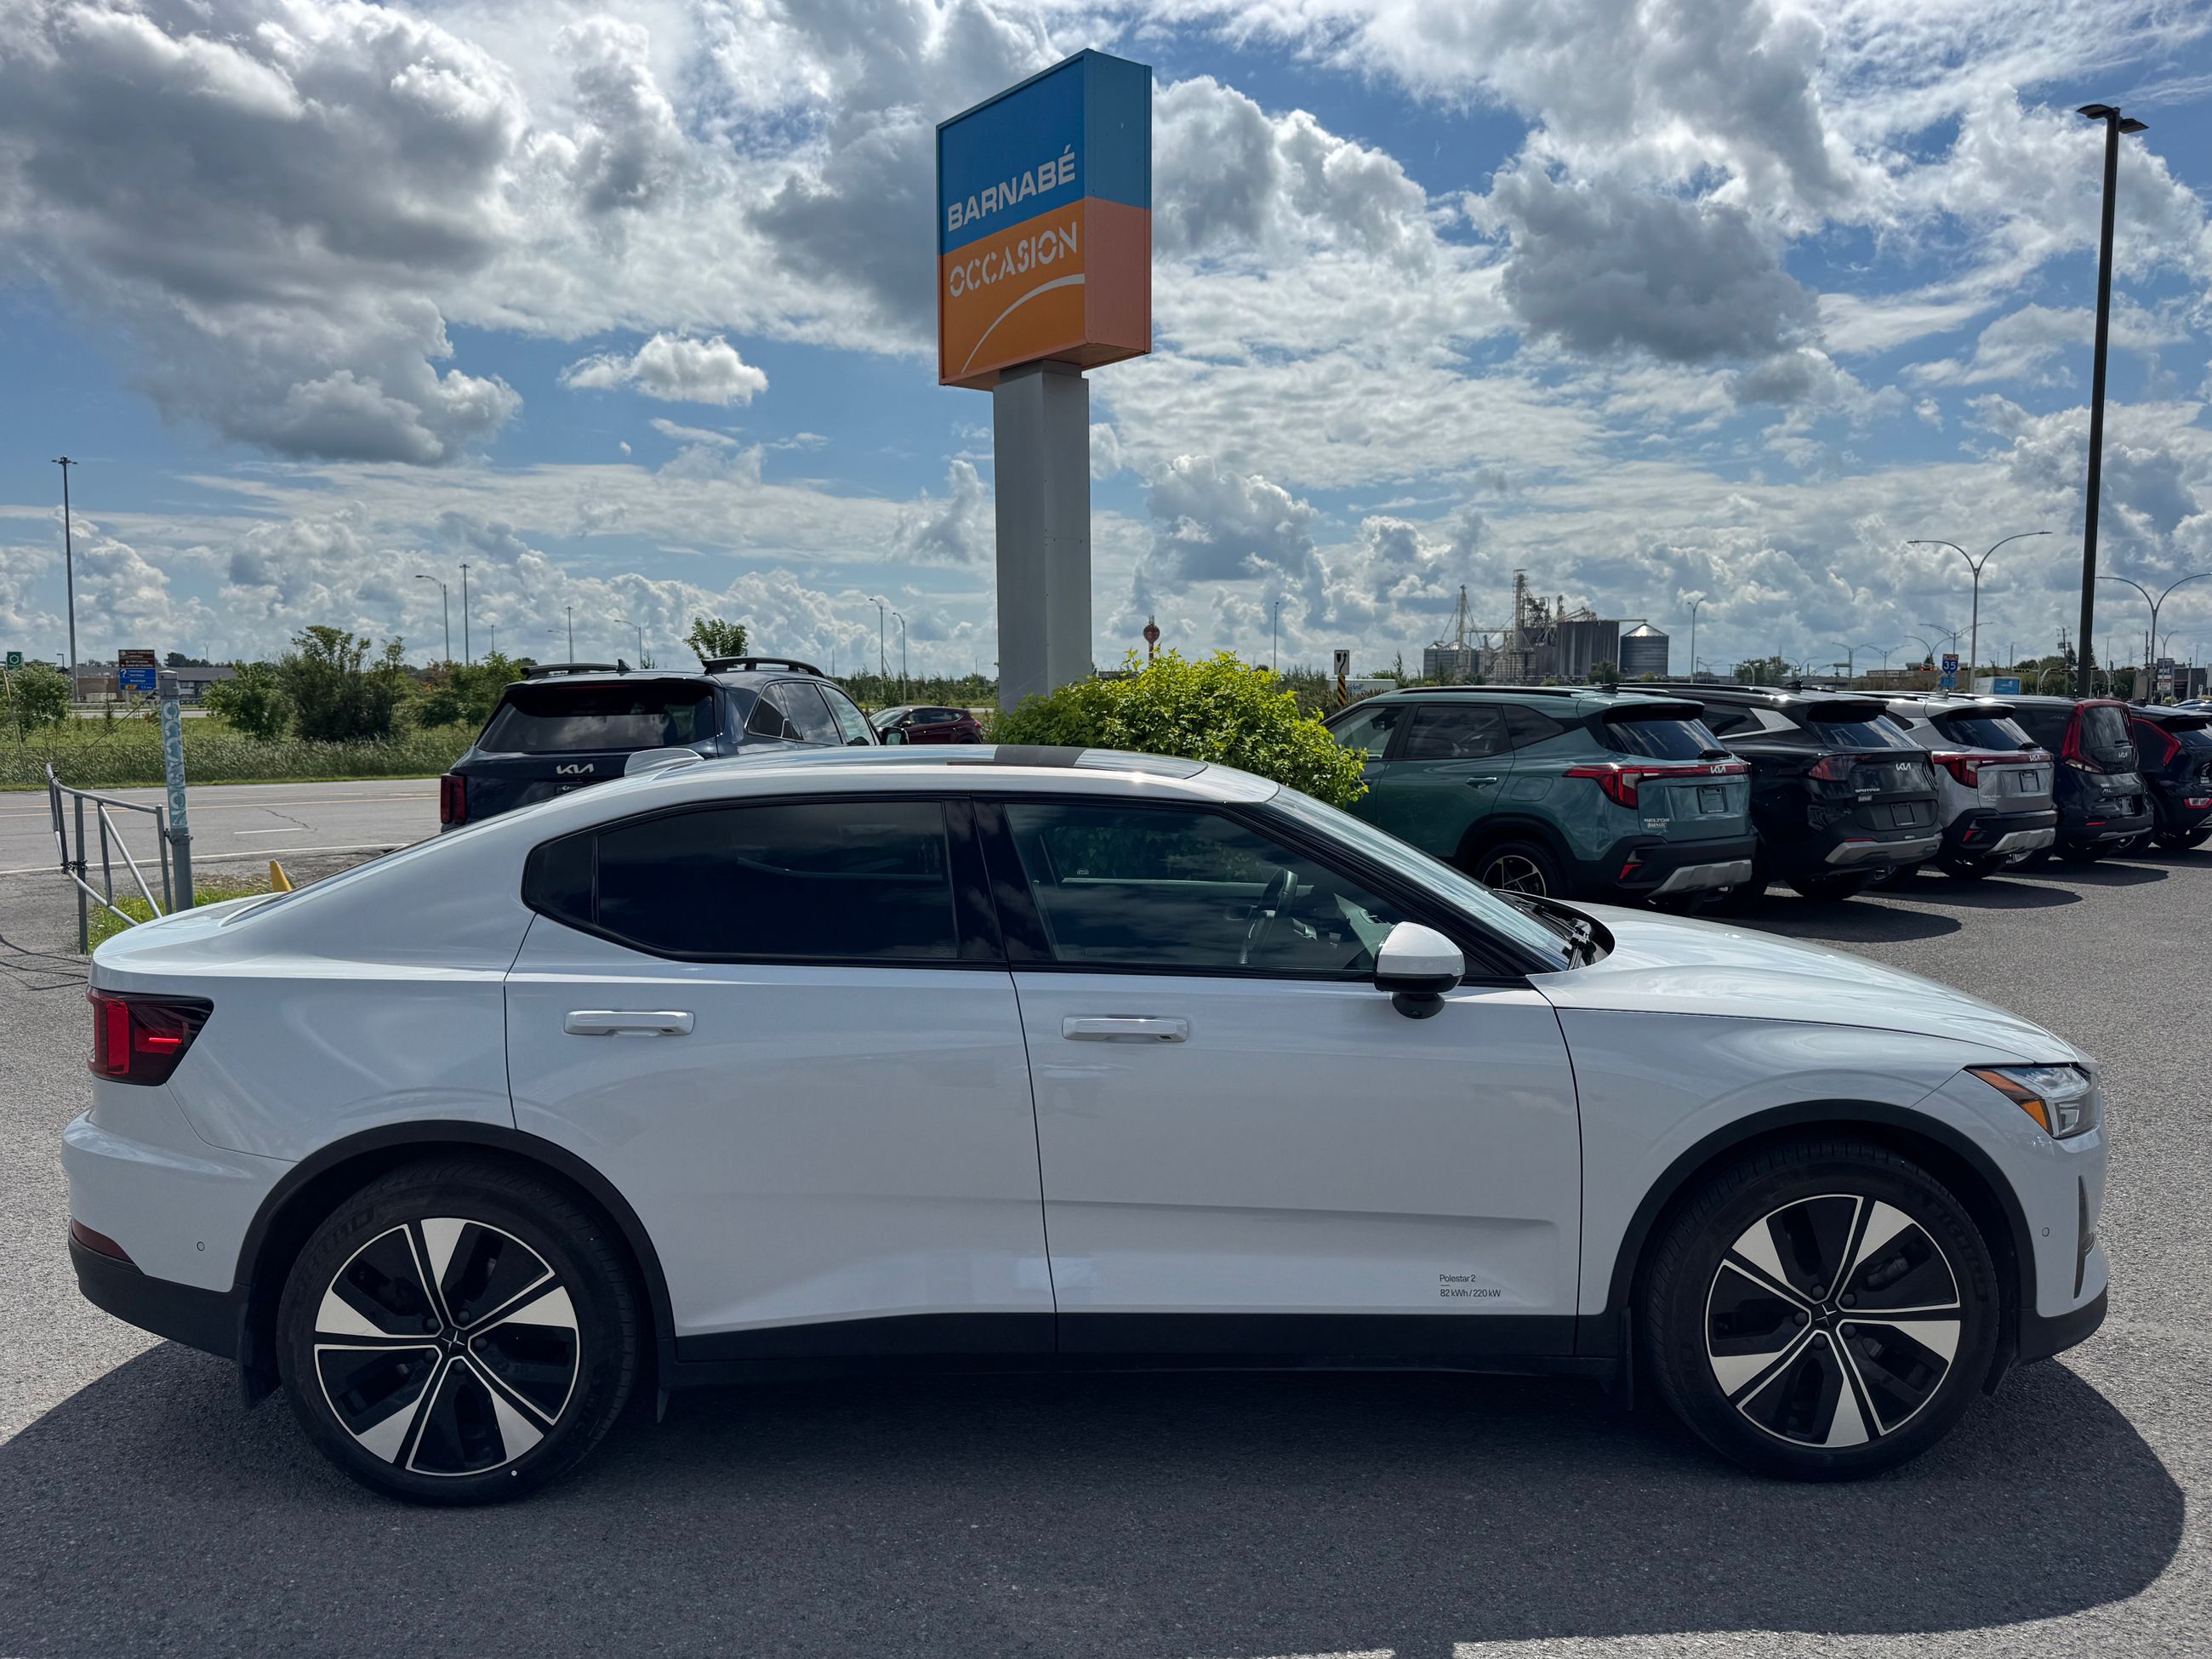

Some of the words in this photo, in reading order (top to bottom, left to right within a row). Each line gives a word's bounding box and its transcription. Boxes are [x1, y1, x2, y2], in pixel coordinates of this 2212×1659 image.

[947, 143, 1076, 232] BARNABÉ
[949, 220, 1078, 298] OCCASION
[1943, 660, 1957, 670] 35
[1439, 1274, 1470, 1283] Polestar
[1470, 1274, 1476, 1283] 2
[1440, 1289, 1451, 1297] 82
[1451, 1289, 1468, 1297] kWh
[1473, 1289, 1488, 1297] 220
[1488, 1289, 1501, 1297] kW
